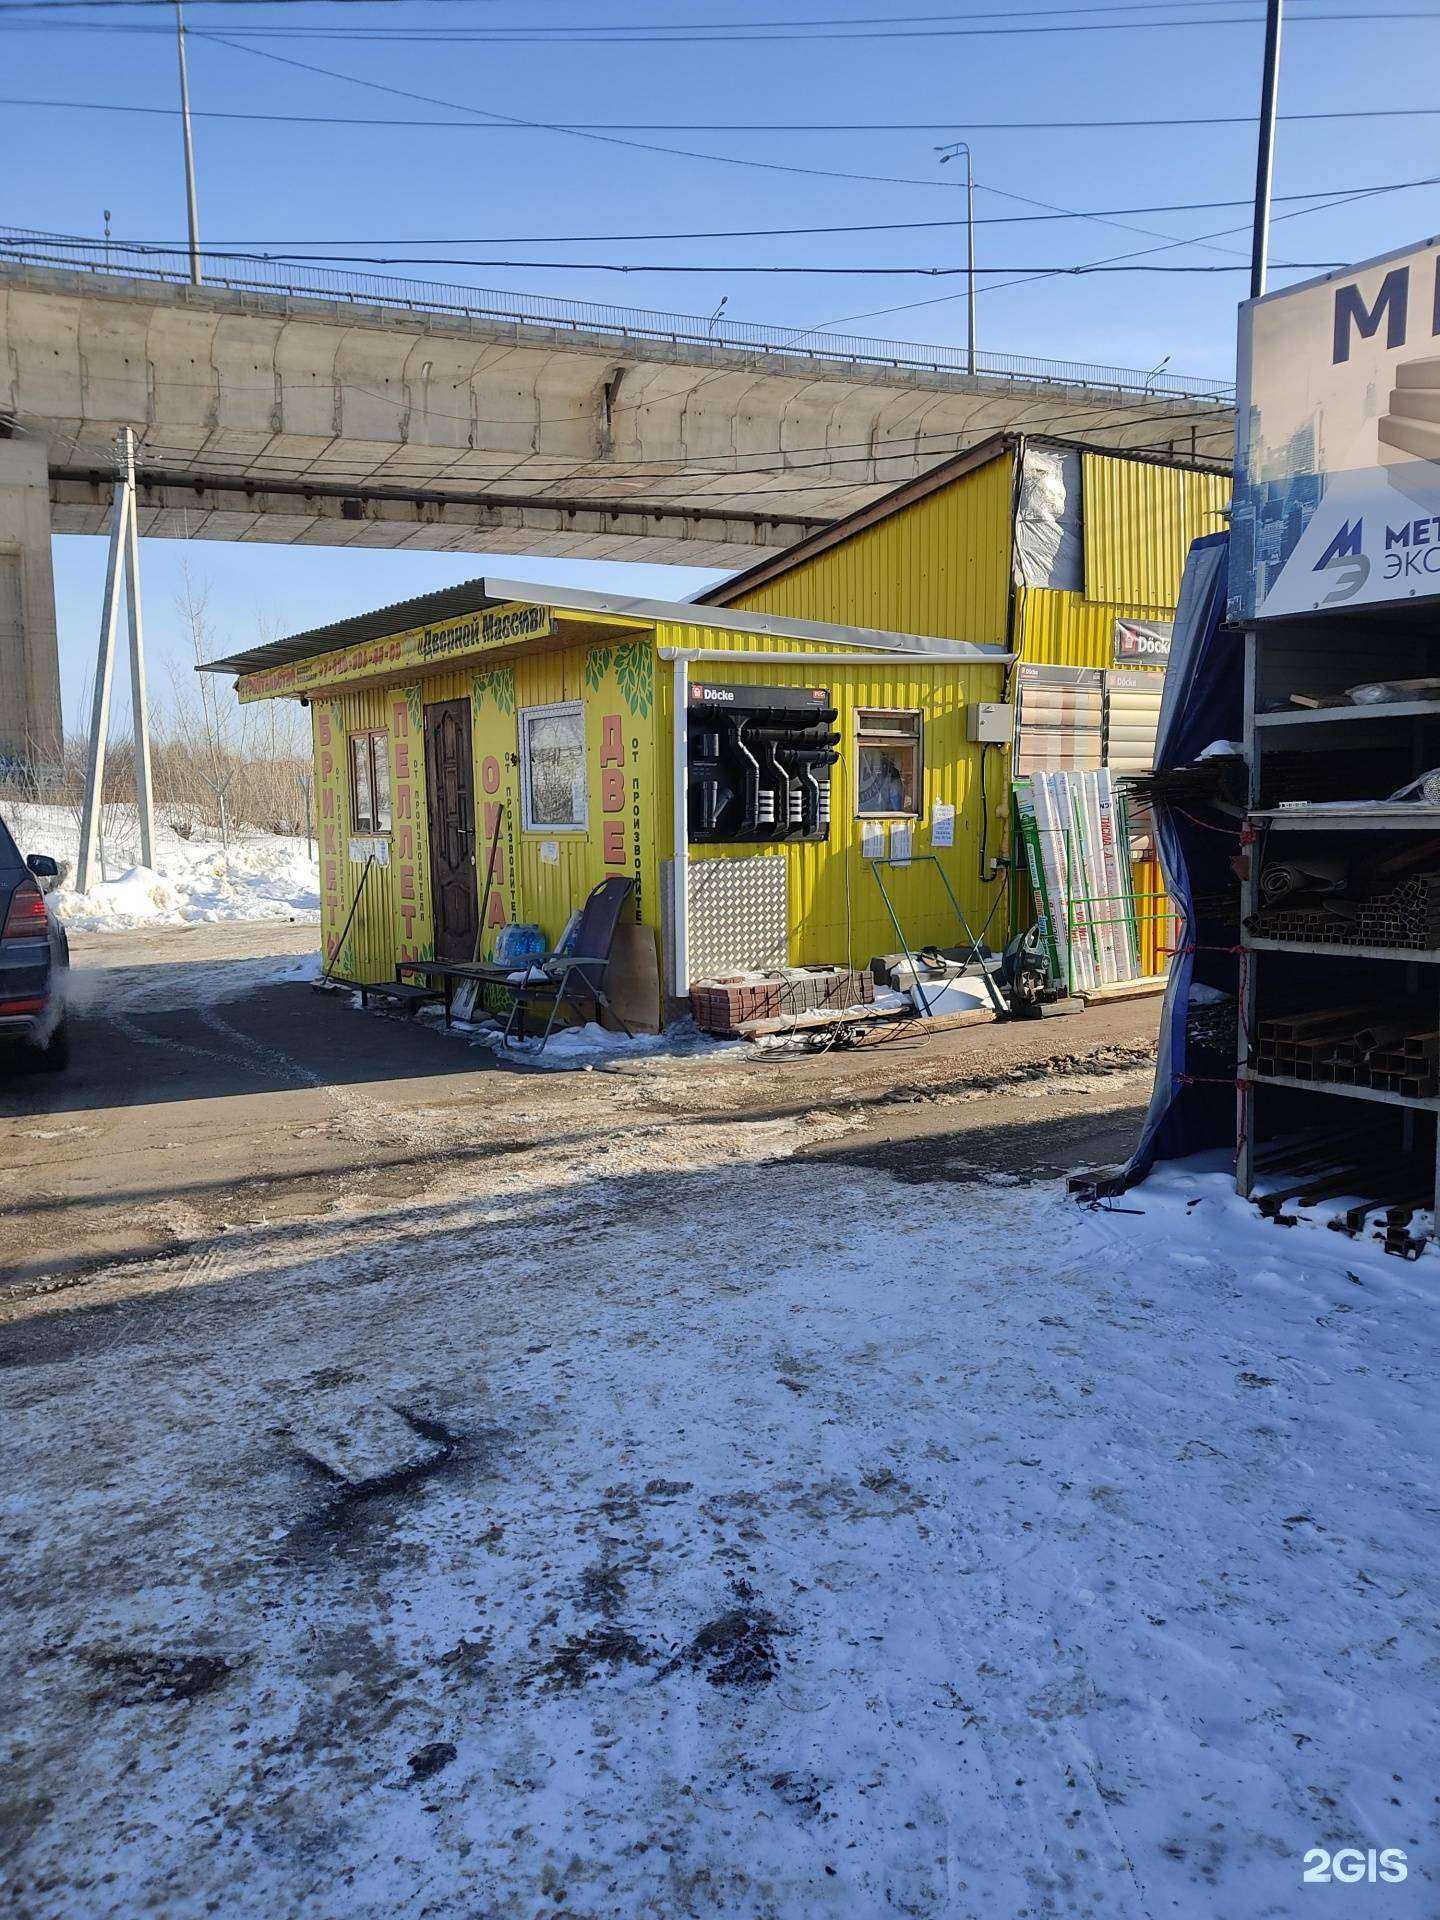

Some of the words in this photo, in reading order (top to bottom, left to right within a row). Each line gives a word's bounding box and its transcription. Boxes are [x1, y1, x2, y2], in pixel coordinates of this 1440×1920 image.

[1332, 265, 1440, 366] М
[704, 689, 735, 701] Döcke
[1137, 635, 1171, 655] Döck
[600, 715, 626, 878] ДВЕ
[631, 738, 639, 763] ОТ
[318, 714, 341, 963] БРИКЕТЫ
[393, 701, 419, 978] ПЕЛЛЕТЫ
[506, 787, 518, 926] ПРОИЗВОДИТЕЛ
[632, 778, 643, 925] ПРОИЗВОДИТЕ
